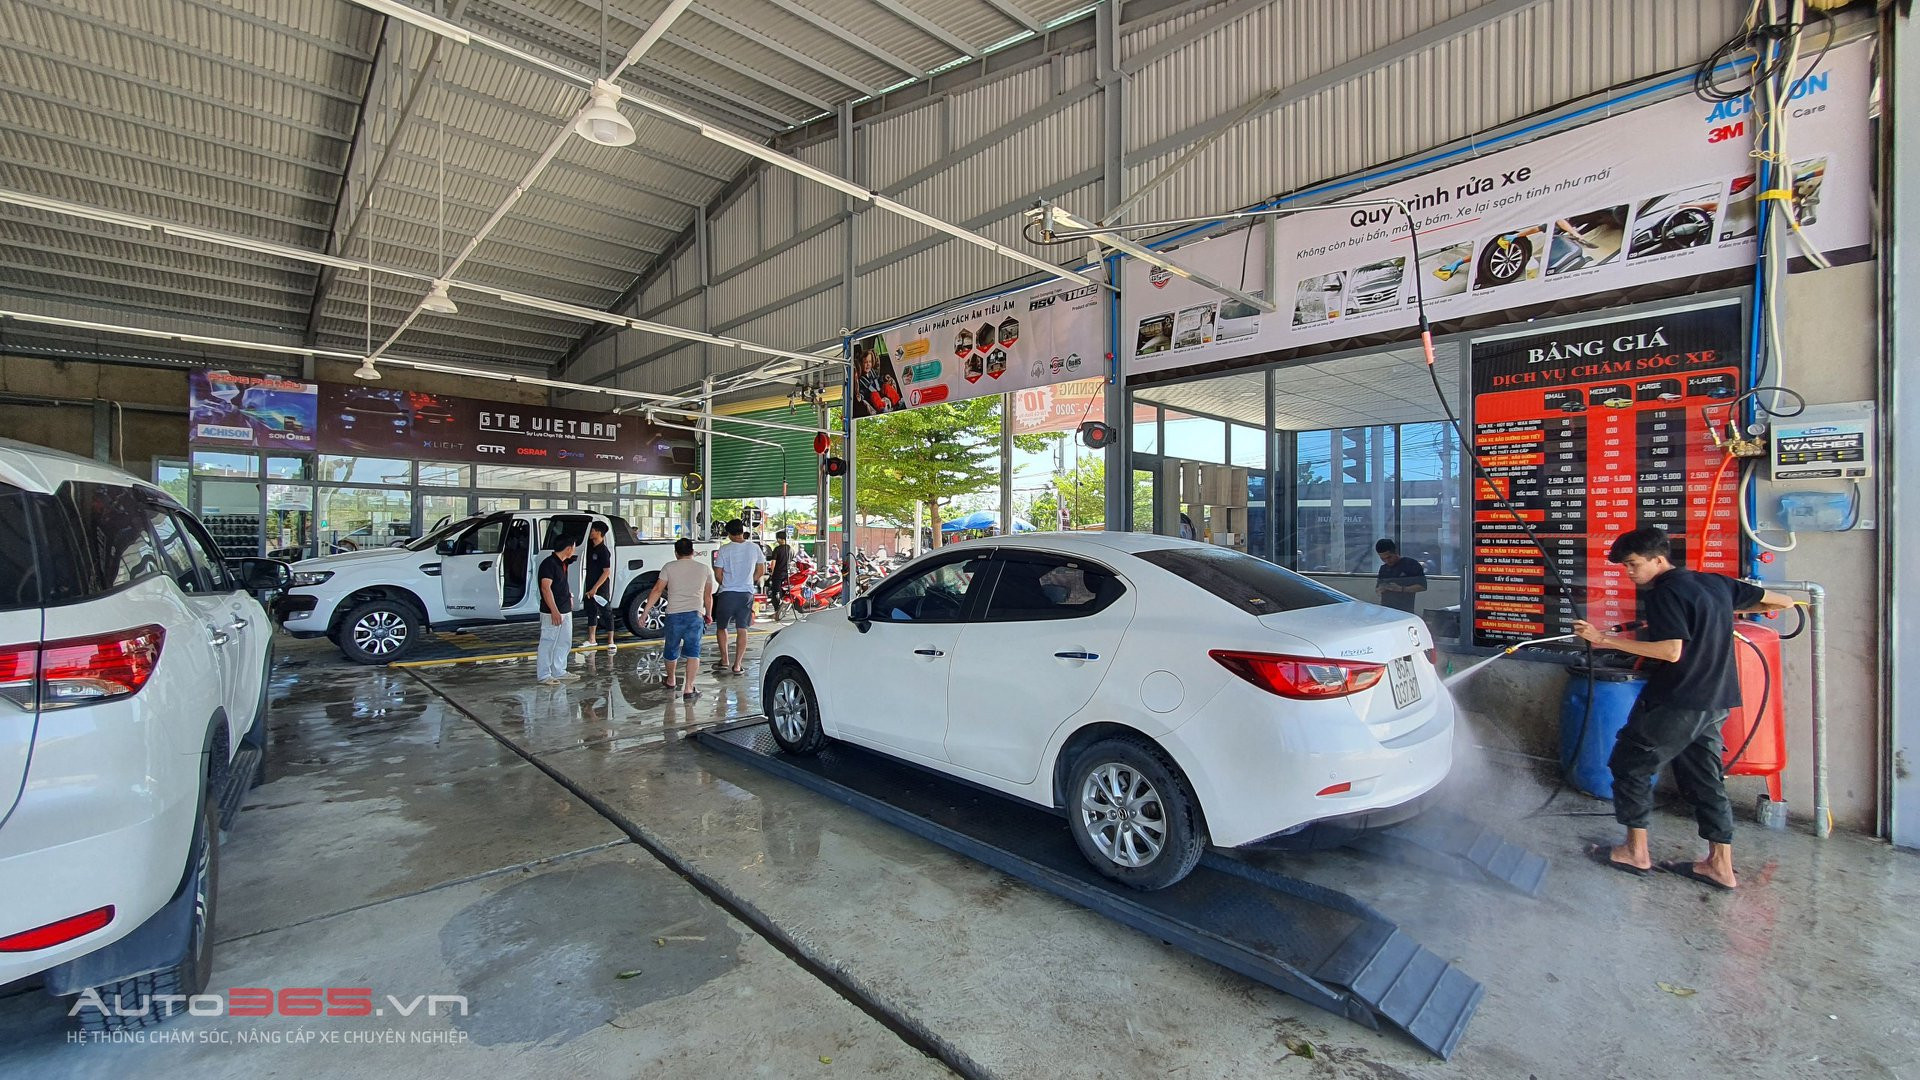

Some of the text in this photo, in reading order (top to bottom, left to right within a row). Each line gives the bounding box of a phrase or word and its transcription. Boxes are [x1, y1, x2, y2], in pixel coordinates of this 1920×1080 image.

[1705, 72, 1829, 123] ACHON
[1792, 104, 1826, 118] Care
[1708, 122, 1743, 143] 3M
[1350, 166, 1531, 227] Quy trình rửa xe
[1297, 246, 1325, 260] Không
[1328, 241, 1345, 252] còn
[1349, 233, 1364, 247] bụi
[1425, 212, 1452, 226] bám.
[1456, 207, 1472, 218] Xe
[1474, 201, 1489, 214] lại
[1492, 192, 1522, 209] sạch
[1554, 177, 1581, 192] như
[1583, 167, 1612, 184] mới
[1065, 284, 1098, 302] 1102
[918, 300, 1015, 335] GIẢI PHÁP CÁCH ÂM TIÊU ÂM
[1528, 326, 1669, 363] BẢNG GIÁ
[1493, 350, 1716, 388] DỊCH VỤ CHĂM SÓC XE
[1637, 382, 1661, 391] LARGE
[1688, 375, 1723, 385] X-LARGE
[1545, 392, 1565, 400] SMALL
[1589, 387, 1617, 396] MEDIUM
[480, 412, 520, 429] GTR
[202, 426, 251, 438] ACHISON
[1806, 434, 1859, 442] PRESSURE
[476, 444, 506, 454] GTR
[517, 447, 547, 456] OSRAM
[1783, 440, 1857, 451] WASHER
